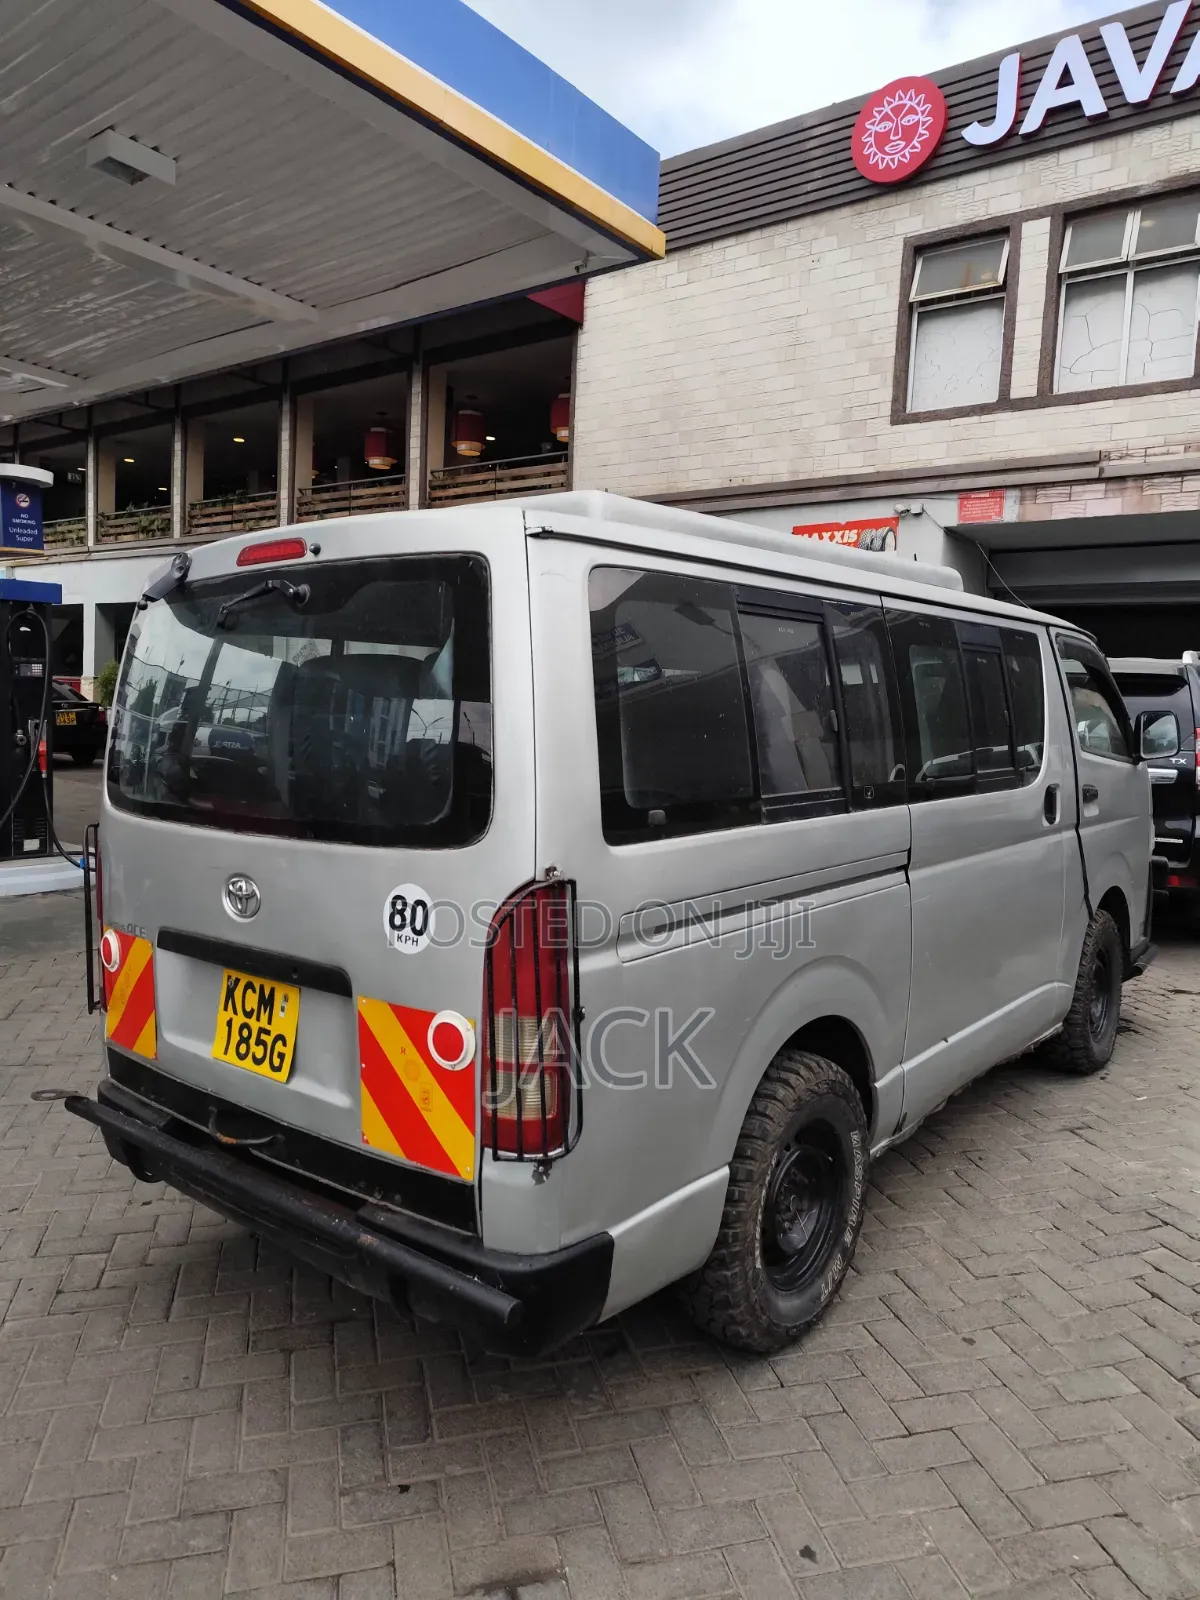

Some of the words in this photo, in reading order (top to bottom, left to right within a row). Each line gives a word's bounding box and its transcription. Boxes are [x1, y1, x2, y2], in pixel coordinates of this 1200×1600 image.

[8, 526, 38, 535] Unleaded
[388, 895, 429, 936] 80
[396, 933, 420, 947] KPH
[223, 975, 276, 1025] KCM
[223, 1018, 288, 1073] 185G
